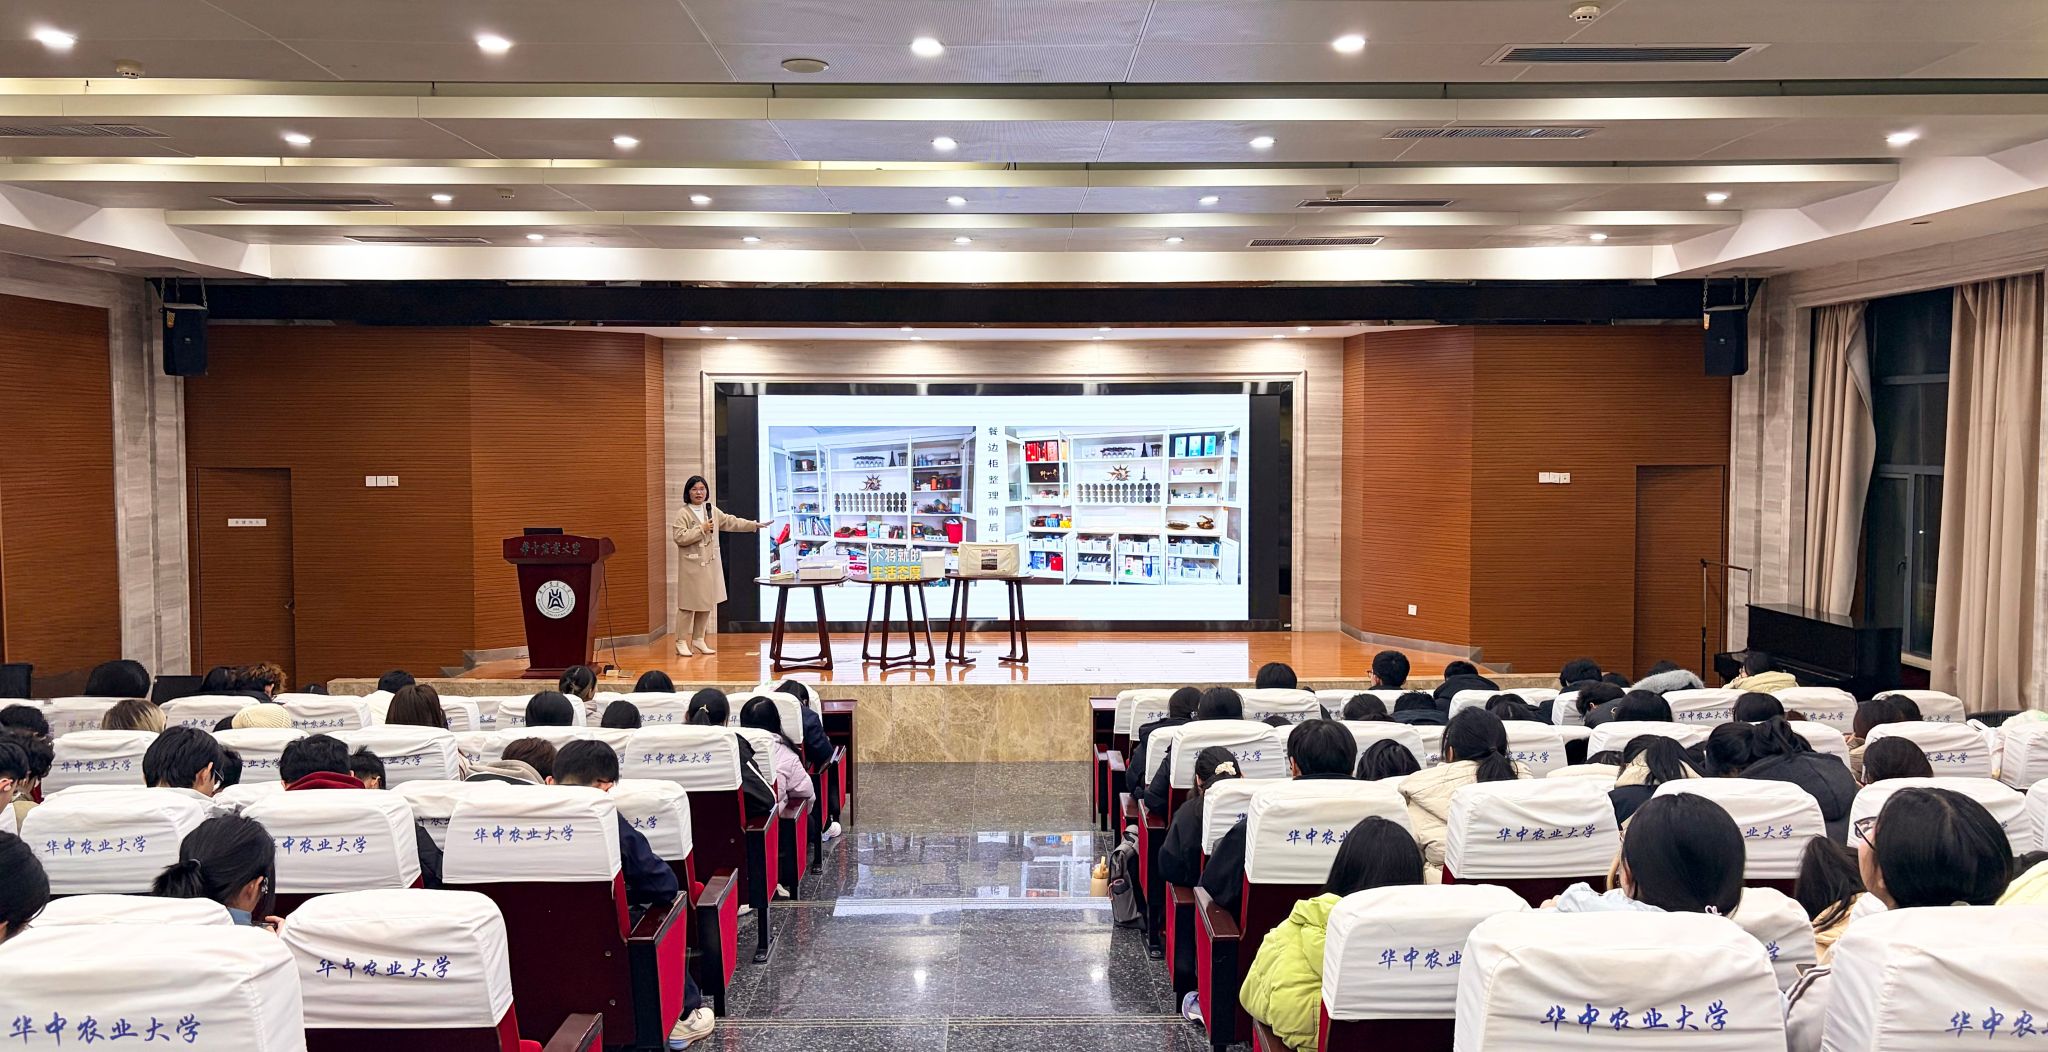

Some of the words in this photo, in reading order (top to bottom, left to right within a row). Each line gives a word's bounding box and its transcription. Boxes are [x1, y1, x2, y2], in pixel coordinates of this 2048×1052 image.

[988, 427, 999, 543] 餐边柜整理前后
[871, 549, 922, 563] 不将就的
[182, 718, 217, 728] 华中农业
[640, 713, 673, 723] 农业大学
[1802, 711, 1845, 721] 农业大学
[61, 758, 132, 773] 华中农业大学
[642, 752, 713, 765] 华中农业大学
[1505, 751, 1551, 764] 农业大学
[1925, 752, 1968, 764] 农业大学
[473, 824, 574, 844] 华中农业大学
[1496, 823, 1596, 843] 华中农业大学
[1744, 824, 1793, 840] 业大学
[45, 835, 147, 856] 华中农业大学
[275, 835, 368, 855] 中农业大学
[316, 954, 452, 979] 华中农业大学
[1378, 945, 1462, 971] 华中农业
[1540, 999, 1729, 1034] 华中农业大学
[1944, 1006, 2048, 1040] 华中农
[9, 1011, 202, 1046] 华中农业大学
